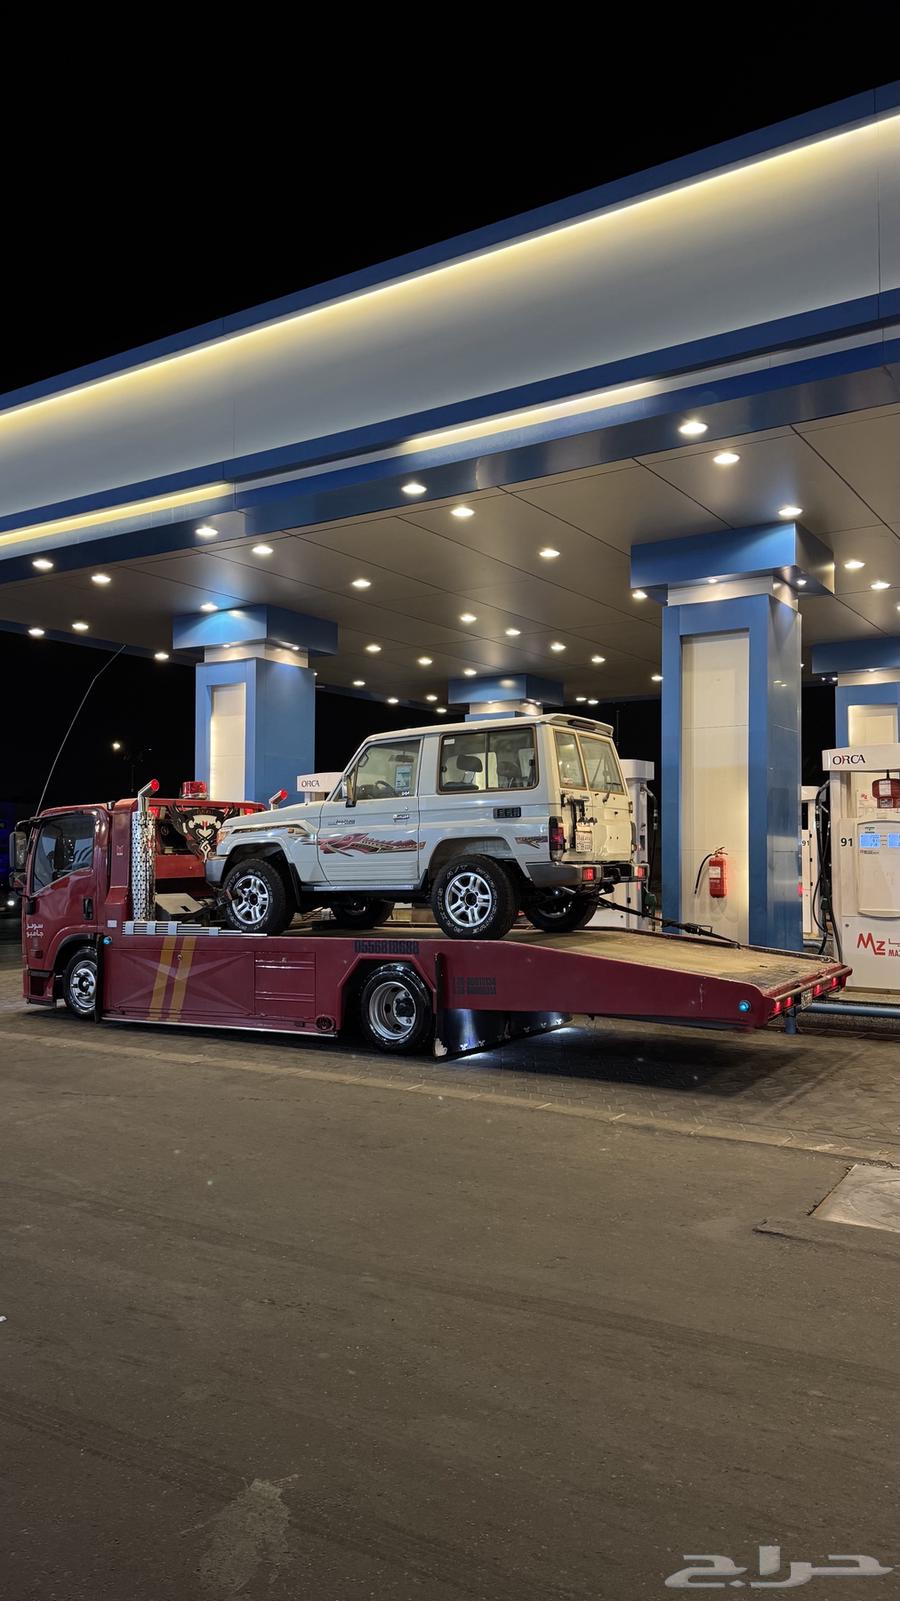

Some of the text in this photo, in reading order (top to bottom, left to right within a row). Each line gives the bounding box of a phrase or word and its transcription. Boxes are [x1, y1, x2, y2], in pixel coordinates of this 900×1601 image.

[833, 754, 866, 765] ORCA
[301, 780, 320, 788] ORCA
[840, 837, 853, 847] 91
